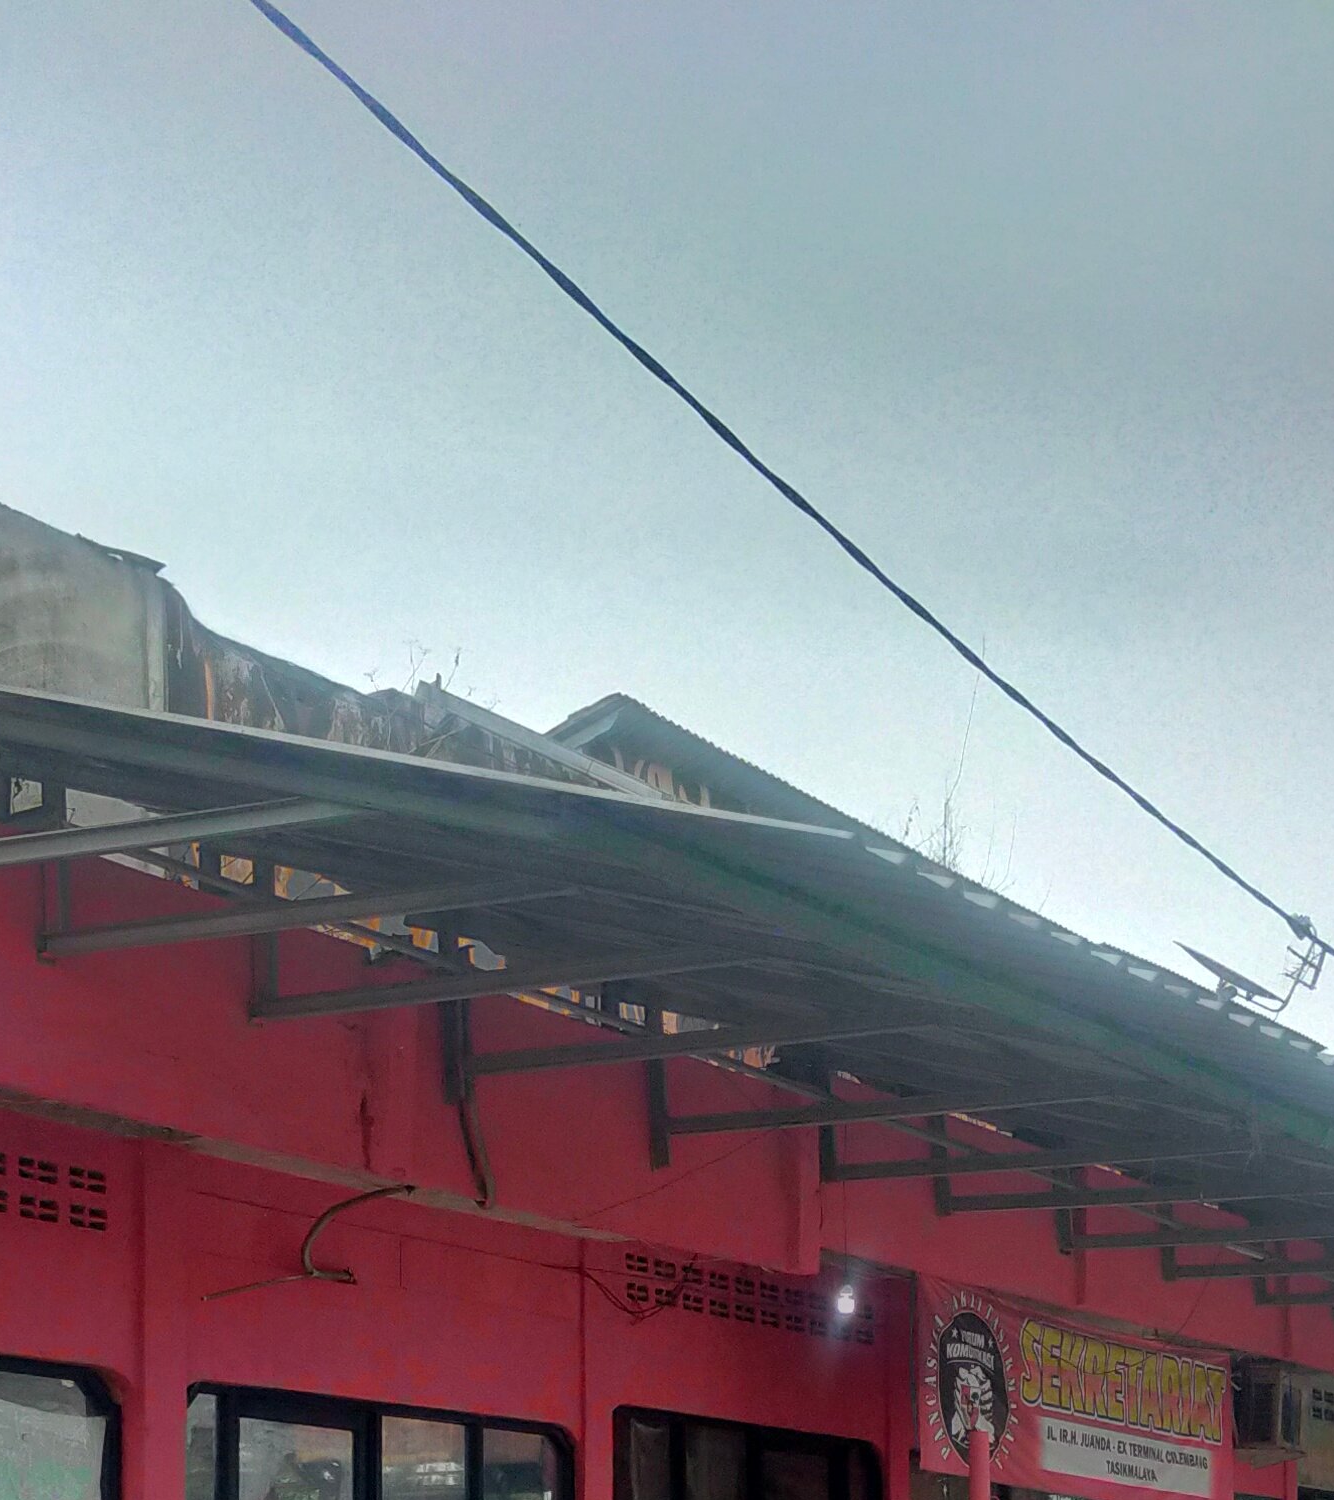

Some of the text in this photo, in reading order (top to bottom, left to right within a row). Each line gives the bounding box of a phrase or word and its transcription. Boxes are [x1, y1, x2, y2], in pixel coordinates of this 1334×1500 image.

[1020, 1319, 1227, 1445] SEKRETARIAT
[1080, 1432, 1112, 1453] JUANDA
[1117, 1440, 1127, 1455] EX
[1129, 1443, 1165, 1464] TERMINAL
[1106, 1460, 1159, 1482] TASIKMALAYA
